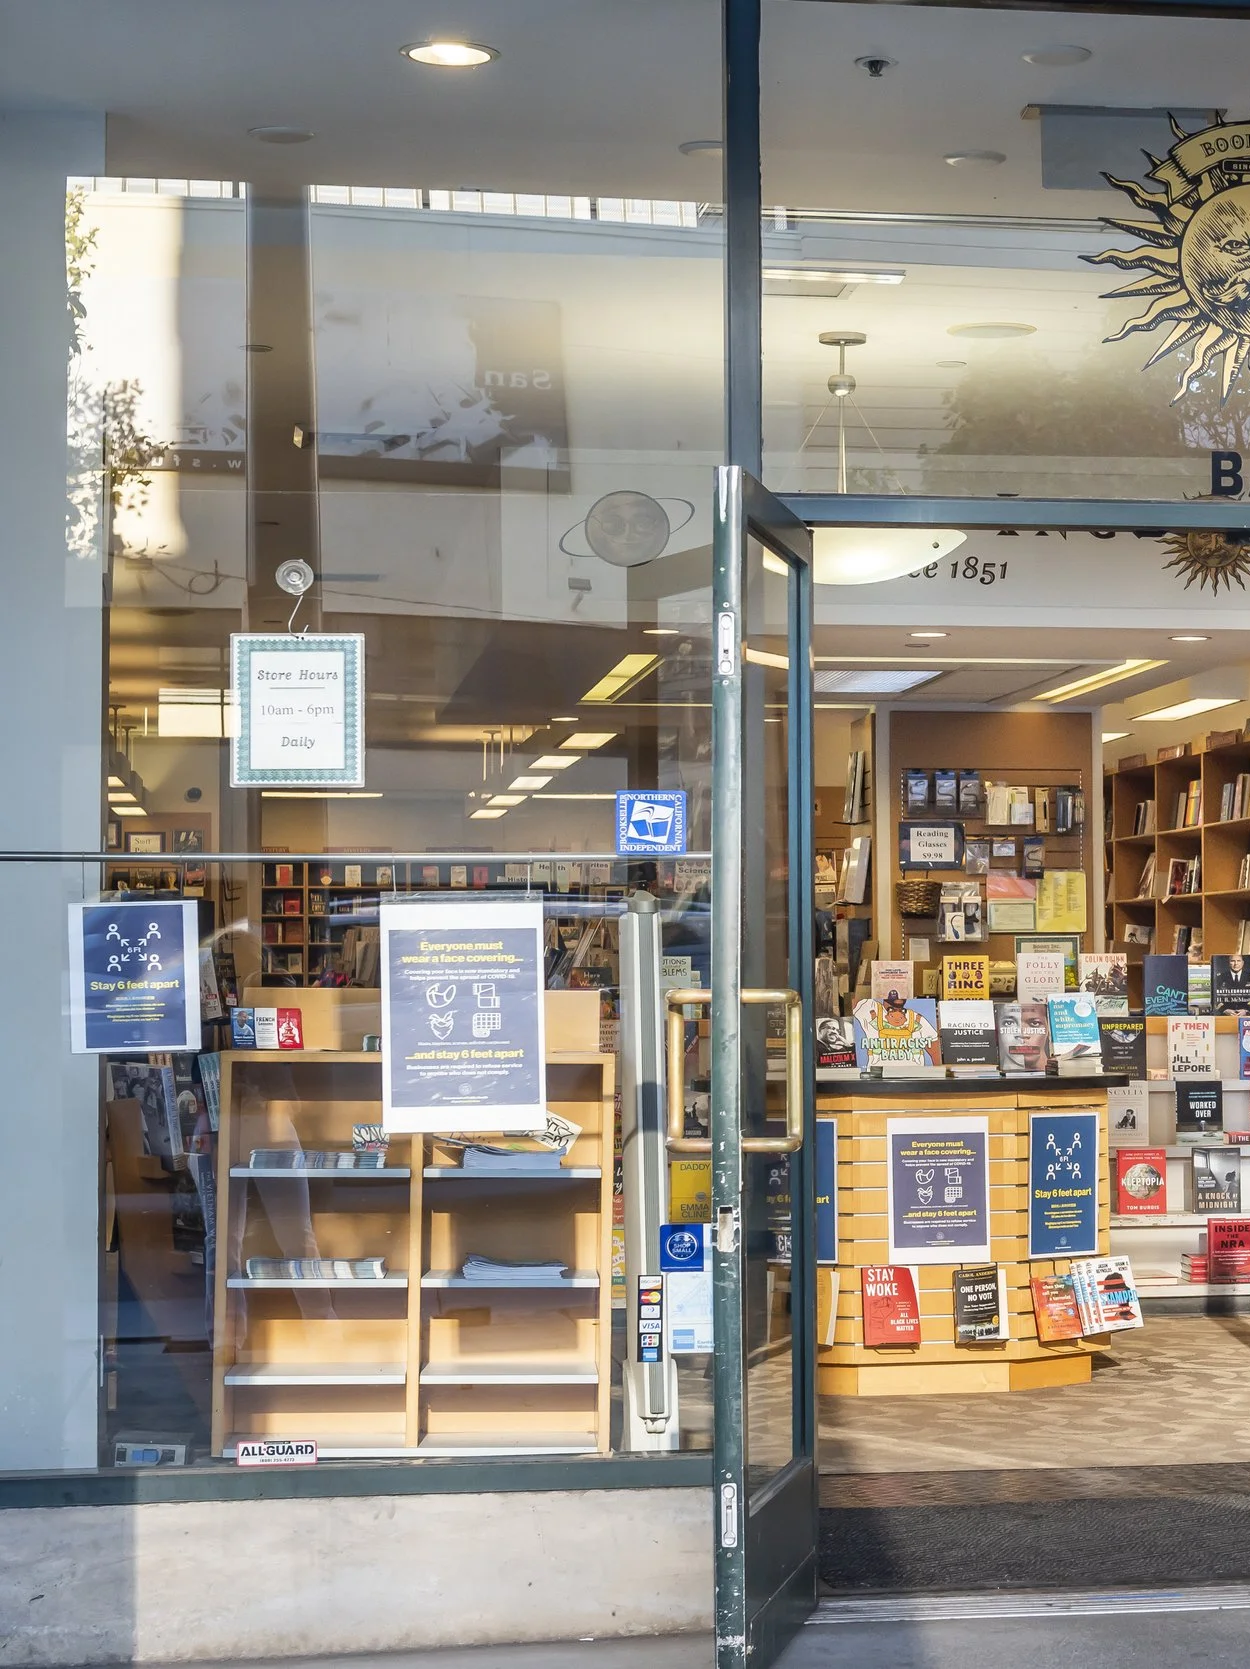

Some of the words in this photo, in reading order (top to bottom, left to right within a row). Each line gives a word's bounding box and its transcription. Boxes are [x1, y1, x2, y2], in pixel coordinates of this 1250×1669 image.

[950, 556, 1008, 585] 1851
[257, 670, 292, 682] Store
[298, 669, 338, 682] Hours
[260, 704, 294, 716] 10am
[306, 703, 334, 718] 6pm
[280, 735, 316, 750] Daily
[626, 793, 676, 801] NORTHERN
[620, 794, 628, 844] BOOKSELLER
[916, 830, 949, 839] Reading
[620, 844, 682, 852] INDEPENDENT
[918, 840, 948, 848] Glasses
[922, 852, 943, 860] $9.98
[420, 942, 474, 952] Everyone
[475, 941, 504, 950] must
[402, 955, 430, 963] wear
[439, 953, 466, 963] face
[947, 962, 984, 970] THREE
[90, 982, 116, 992] Stay
[117, 981, 125, 989] 6
[126, 980, 149, 989] feet
[150, 980, 180, 990] apart
[948, 980, 984, 989] RING
[1156, 985, 1187, 1000] CAN'T
[1146, 996, 1168, 1005] EVEN
[1172, 1023, 1181, 1032] IF
[862, 1038, 932, 1050] ANTIRACIST
[436, 1051, 460, 1060] stay
[461, 1050, 470, 1059] 6
[470, 1050, 494, 1059] feet
[494, 1049, 524, 1060] apart
[882, 1050, 912, 1060] BABY
[1172, 1054, 1191, 1063] JILL
[820, 1056, 850, 1064] MALCOLM
[1189, 1101, 1217, 1109] WORKED
[1195, 1110, 1211, 1118] OVER
[1121, 1177, 1164, 1186] KLEPTOPIA
[1035, 1190, 1052, 1199] Stay
[1058, 1189, 1073, 1197] feet
[1073, 1188, 1092, 1198] apart
[1199, 1201, 1238, 1209] MIDNIGHT
[1215, 1225, 1250, 1233] INSIDE
[1220, 1240, 1245, 1248] NRA
[868, 1269, 894, 1282] STAY
[866, 1283, 899, 1296] WOKE
[974, 1283, 996, 1292] PERSON,
[978, 1292, 993, 1300] VOTE
[1100, 1290, 1137, 1306] STAMPED
